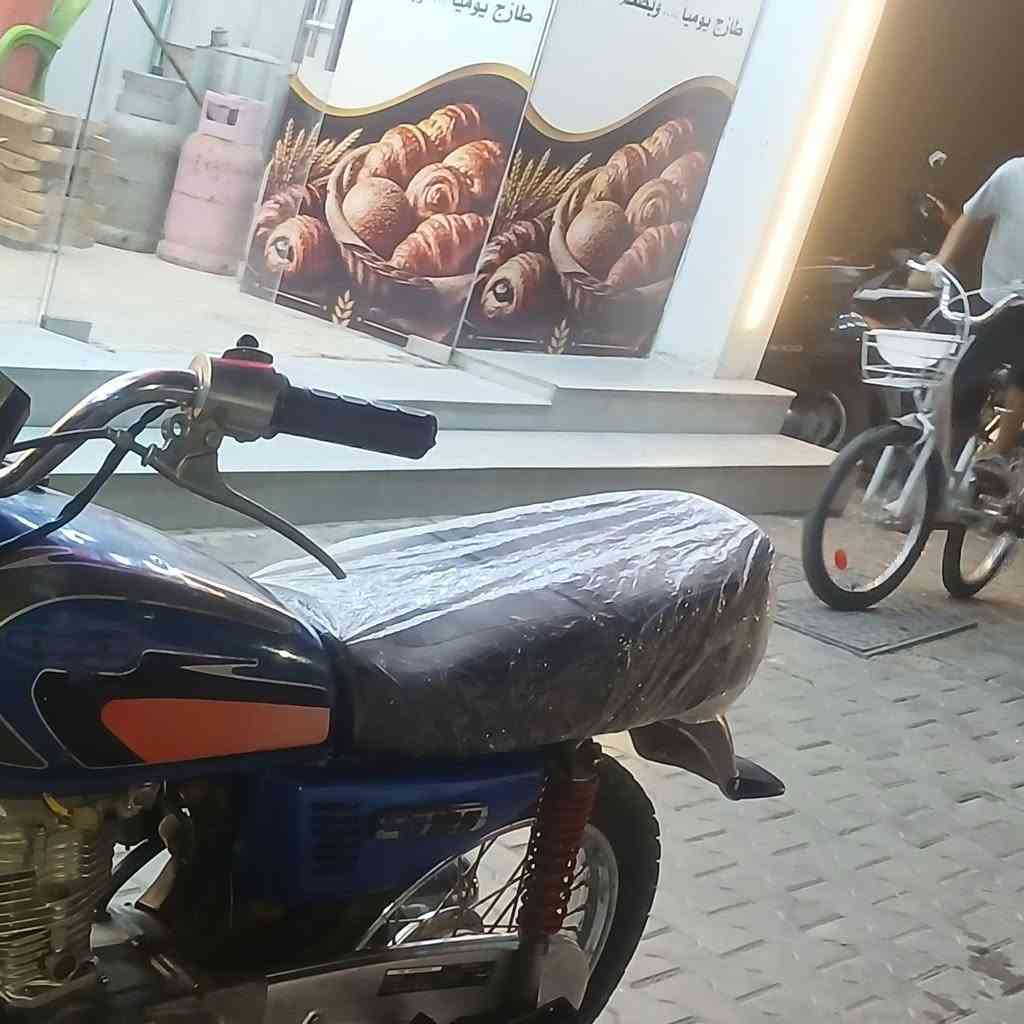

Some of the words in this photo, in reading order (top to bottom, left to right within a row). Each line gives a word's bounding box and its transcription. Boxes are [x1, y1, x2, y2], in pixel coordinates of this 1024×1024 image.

[492, 2, 533, 23] طازج
[681, 8, 712, 31] يوميا
[713, 16, 743, 37] طازج
